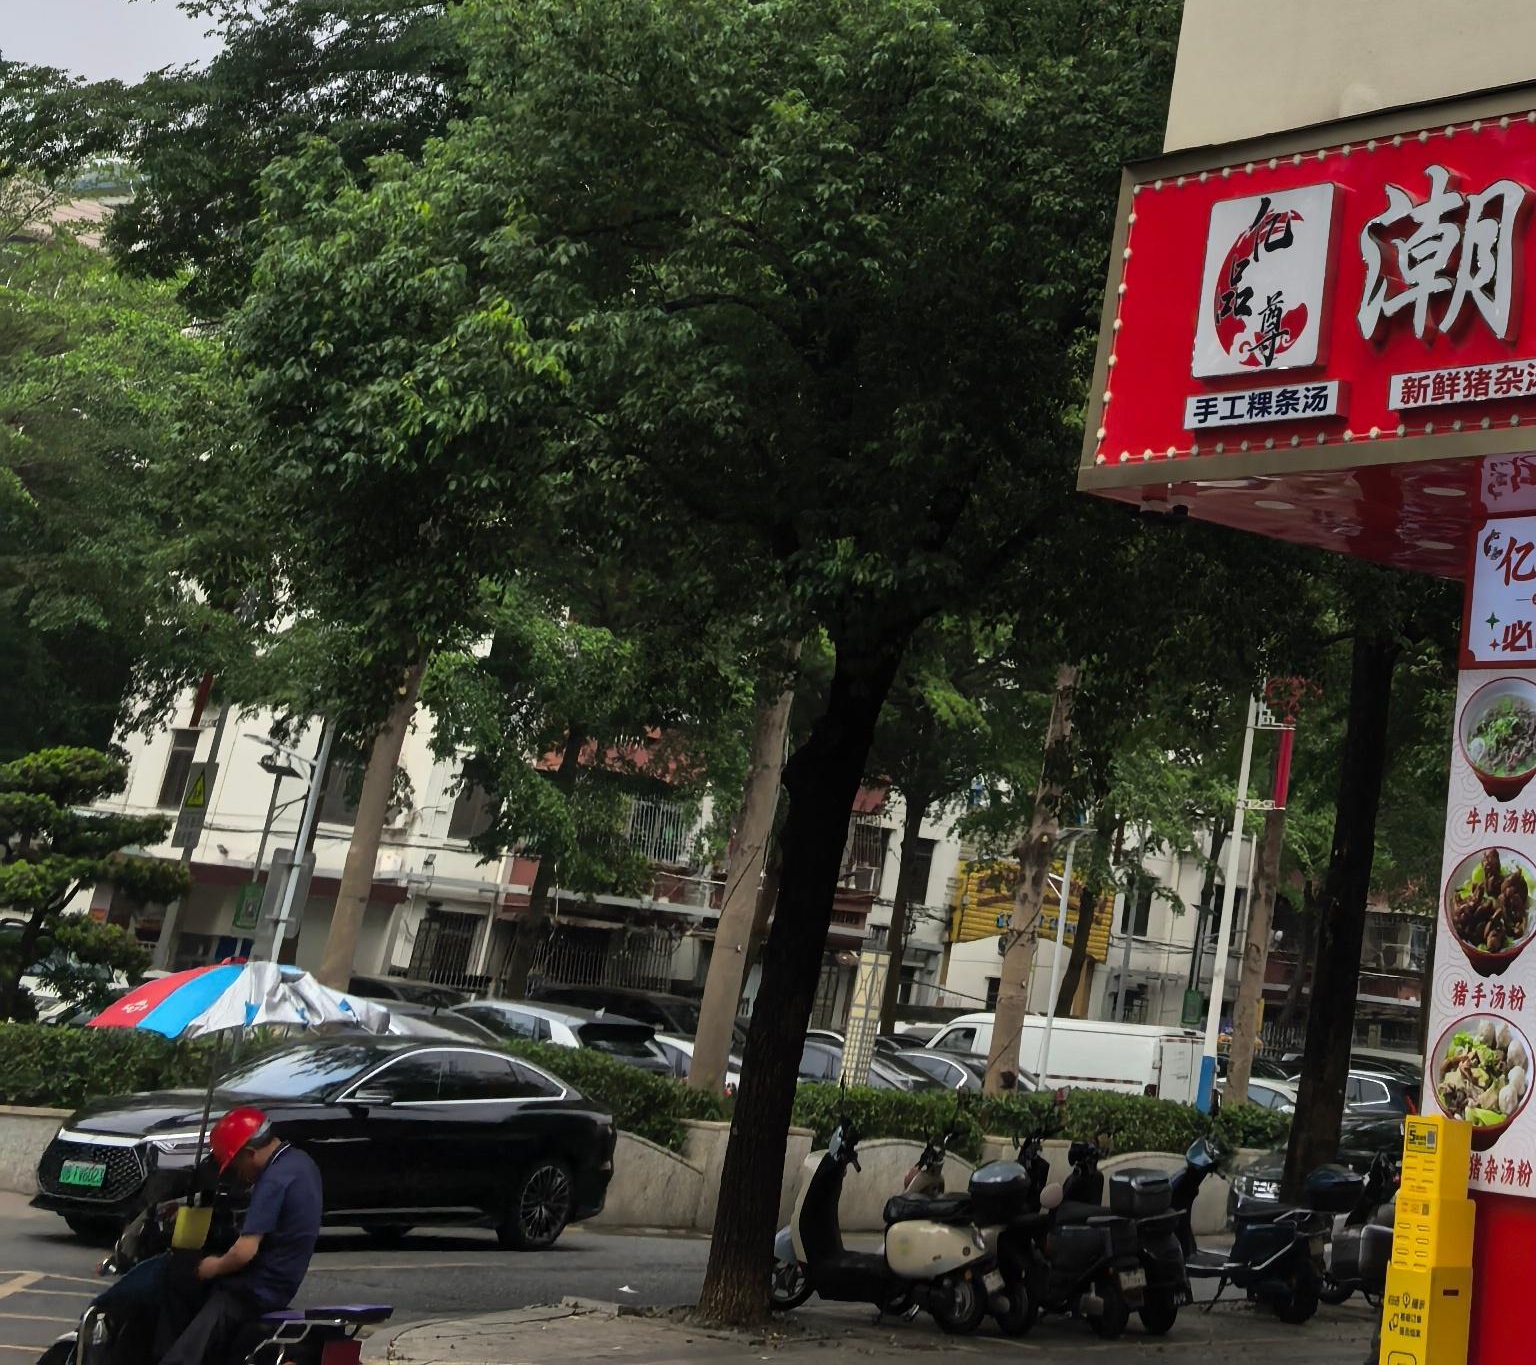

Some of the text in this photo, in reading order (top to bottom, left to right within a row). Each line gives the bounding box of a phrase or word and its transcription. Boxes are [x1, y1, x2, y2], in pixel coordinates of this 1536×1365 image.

[1214, 195, 1295, 367] 亿品尊
[1193, 386, 1329, 425] 手工粿条汤
[1451, 981, 1527, 1012] 猪手汤粉
